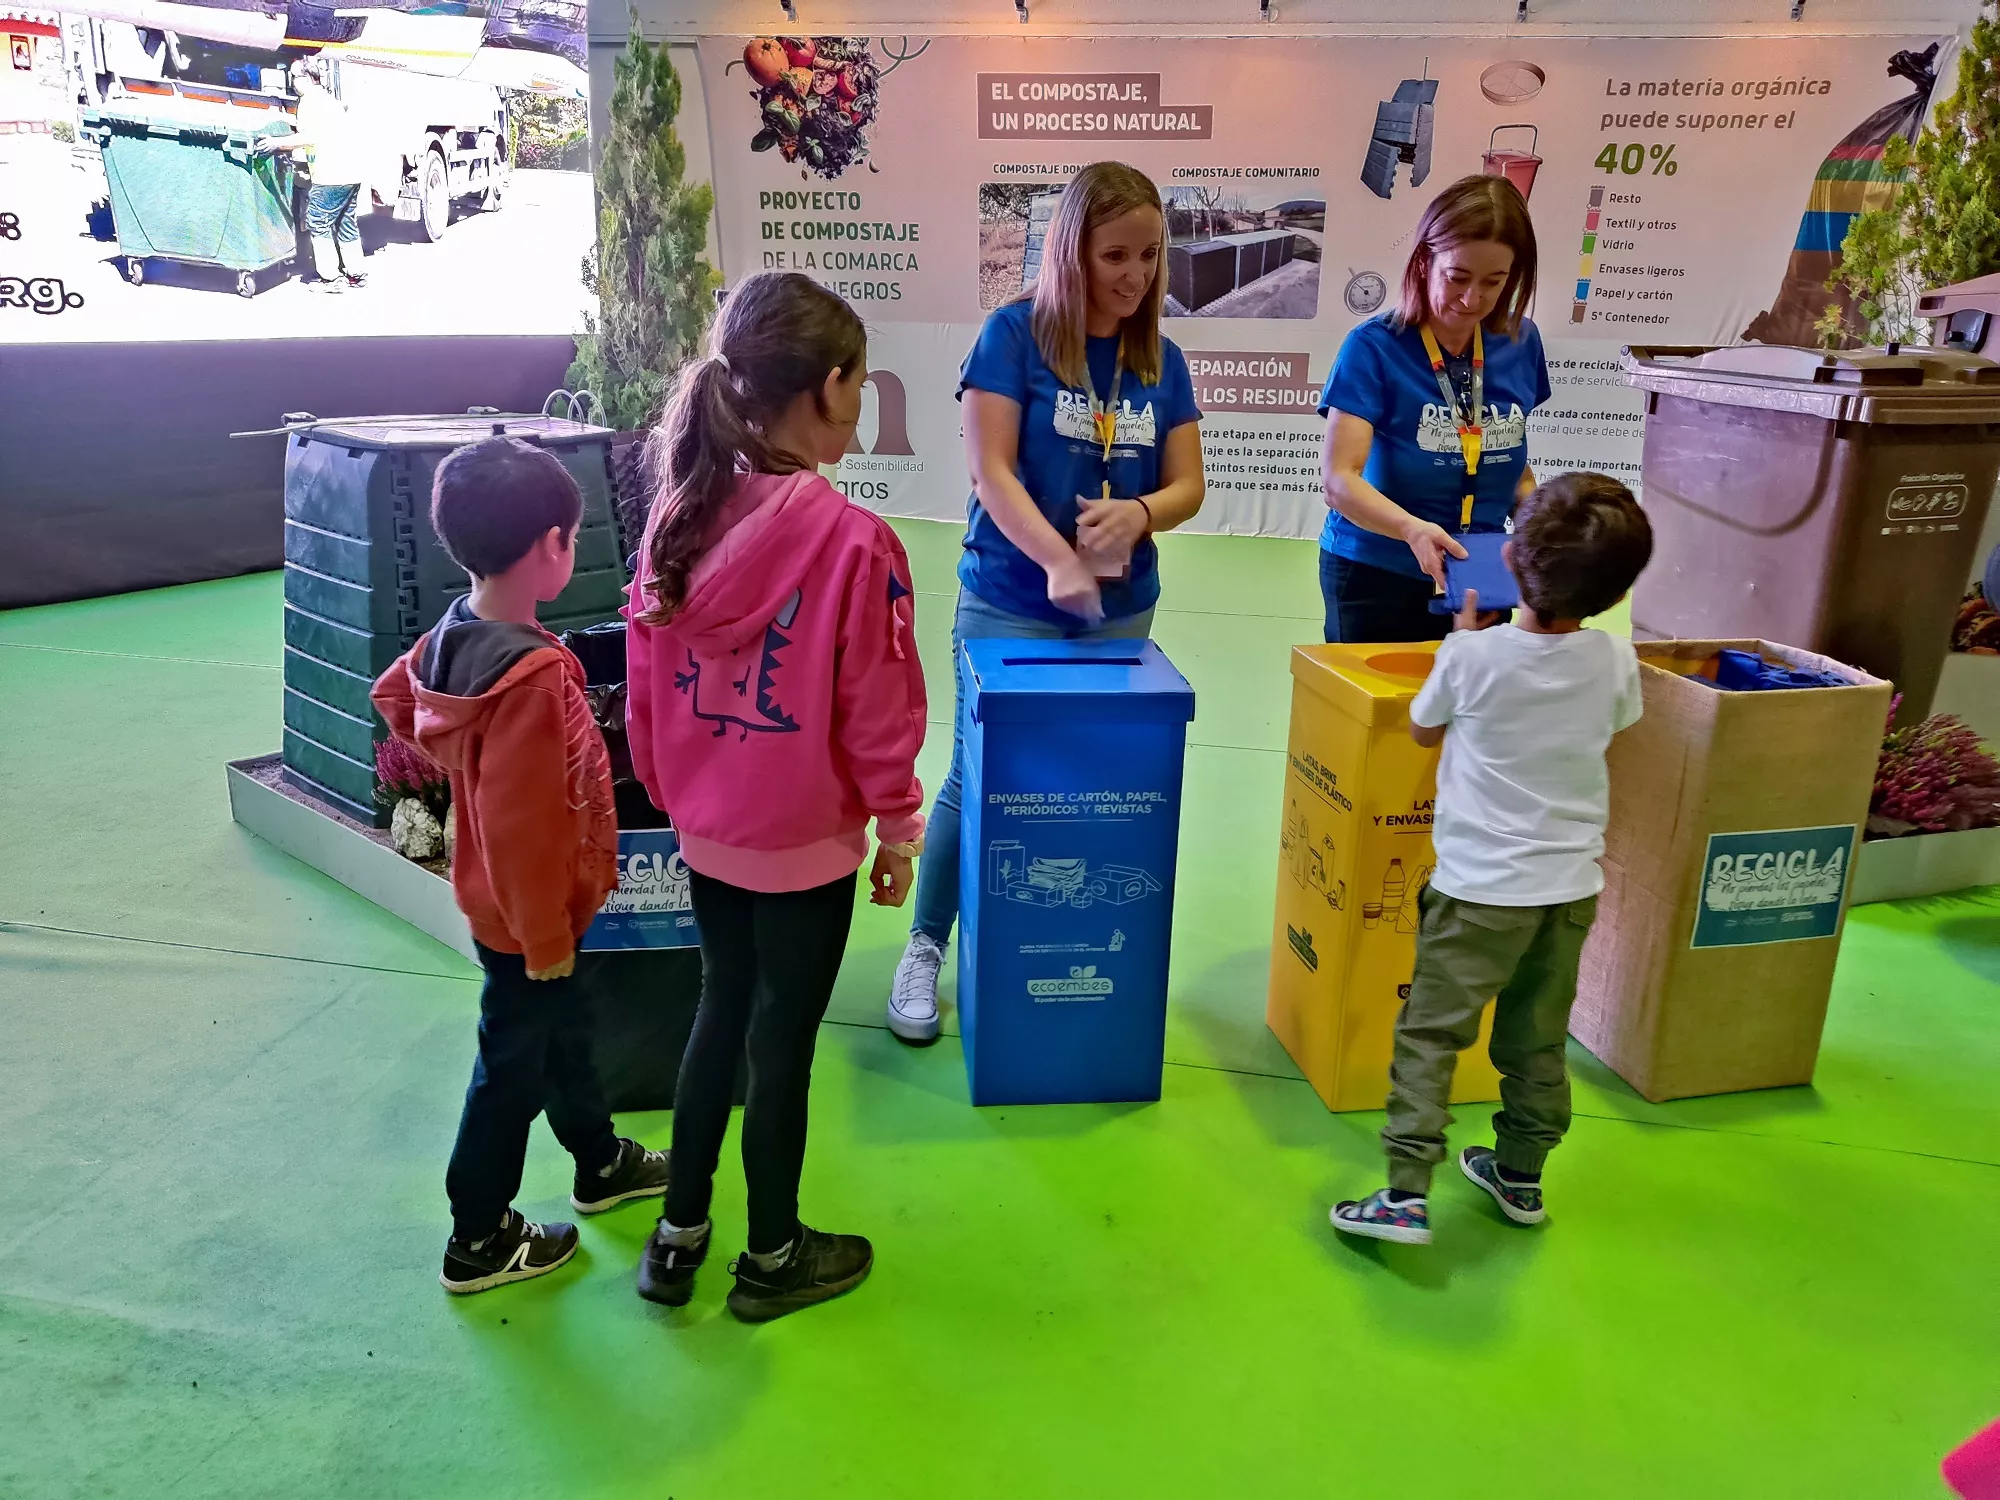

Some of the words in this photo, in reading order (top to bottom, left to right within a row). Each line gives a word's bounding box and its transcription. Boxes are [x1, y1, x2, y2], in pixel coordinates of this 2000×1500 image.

[991, 82, 1013, 100] EL
[1018, 83, 1148, 103] COMPOSTAJE,
[1606, 79, 1631, 96] La
[1638, 78, 1724, 96] materia
[1731, 76, 1832, 100] orgánica
[992, 112, 1018, 130] UN
[1023, 113, 1108, 131] PROCESO
[1113, 113, 1202, 131] NATURAL
[1600, 111, 1669, 131] puede
[1675, 114, 1768, 132] suponer
[1774, 111, 1796, 129] el
[1594, 143, 1678, 176] 40%
[993, 163, 1060, 174] COMPOSTAJE
[1172, 168, 1242, 178] COMPOSTAJE
[1245, 168, 1320, 178] COMUNITARIO
[759, 191, 861, 210] PROYECTO
[1609, 193, 1642, 204] Resto
[761, 221, 785, 240] DE
[790, 222, 920, 241] COMPOSTAJE
[1606, 218, 1635, 229] Textil
[1638, 220, 1645, 231] y
[1647, 220, 1677, 230] otros
[1602, 239, 1634, 250] Vidrio
[763, 251, 786, 270] DE
[792, 252, 817, 270] LA
[822, 252, 919, 271] COMARCA
[1599, 264, 1645, 275] Envases
[1647, 265, 1685, 278] ligeros
[824, 281, 902, 301] NEGROS
[1595, 288, 1626, 300] Papel
[1628, 290, 1635, 300] y
[1637, 290, 1673, 300] cartón
[1605, 312, 1670, 324] Contenedor
[1189, 357, 1291, 378] EPARACIÓN
[1546, 361, 1560, 369] es
[1563, 360, 1576, 369] de
[1550, 377, 1568, 385] eas
[1570, 376, 1585, 386] de
[1587, 377, 1620, 387] servic
[1202, 388, 1237, 403] LOS
[1243, 389, 1322, 406] RESIDUO
[1056, 390, 1155, 422] RELA
[1421, 403, 1525, 428] RELA
[1529, 408, 1550, 419] nte
[1553, 409, 1578, 419] cada
[1581, 410, 1643, 422] contenedor
[1201, 430, 1220, 438] era
[1222, 429, 1255, 441] etapa
[1258, 431, 1273, 440] en
[1275, 431, 1286, 440] el
[1526, 423, 1559, 434] aterial
[1562, 426, 1583, 436] que
[1585, 426, 1598, 435] se
[1601, 427, 1629, 437] debe
[1632, 429, 1645, 439] de
[1203, 446, 1224, 457] laje
[1227, 447, 1240, 456] es
[1243, 446, 1253, 456] la
[1256, 448, 1319, 459] separación
[845, 459, 924, 472] Sostenibilidad
[1202, 463, 1245, 473] istintos
[1248, 464, 1298, 475] residuos
[1301, 468, 1315, 476] en
[1544, 458, 1574, 468] sobre
[1577, 459, 1586, 468] la
[836, 481, 889, 499] gros
[1207, 479, 1232, 490] Para
[1235, 481, 1256, 492] que
[1259, 482, 1279, 491] sea
[1282, 482, 1304, 492] más
[1308, 482, 1324, 493] fác
[988, 793, 1045, 804] ENVASES
[1047, 793, 1065, 803] DE
[1068, 790, 1123, 803] CARTÓN,
[1126, 791, 1167, 803] PAPEL,
[1315, 775, 1323, 790] DE
[1323, 782, 1352, 812] PLÁSTICO
[1004, 803, 1079, 816] PERIÓDICOS
[1081, 805, 1090, 814] Y
[1094, 803, 1152, 815] REVISTAS
[1413, 800, 1435, 811] LAT
[1373, 816, 1383, 826] Y
[1386, 814, 1434, 826] ENVAS
[1711, 846, 1845, 884] RECICLA
[660, 881, 676, 894] los
[605, 900, 635, 914] sigue
[640, 899, 675, 911] dando
[679, 898, 690, 909] la
[1030, 981, 1110, 993] ecoembes
